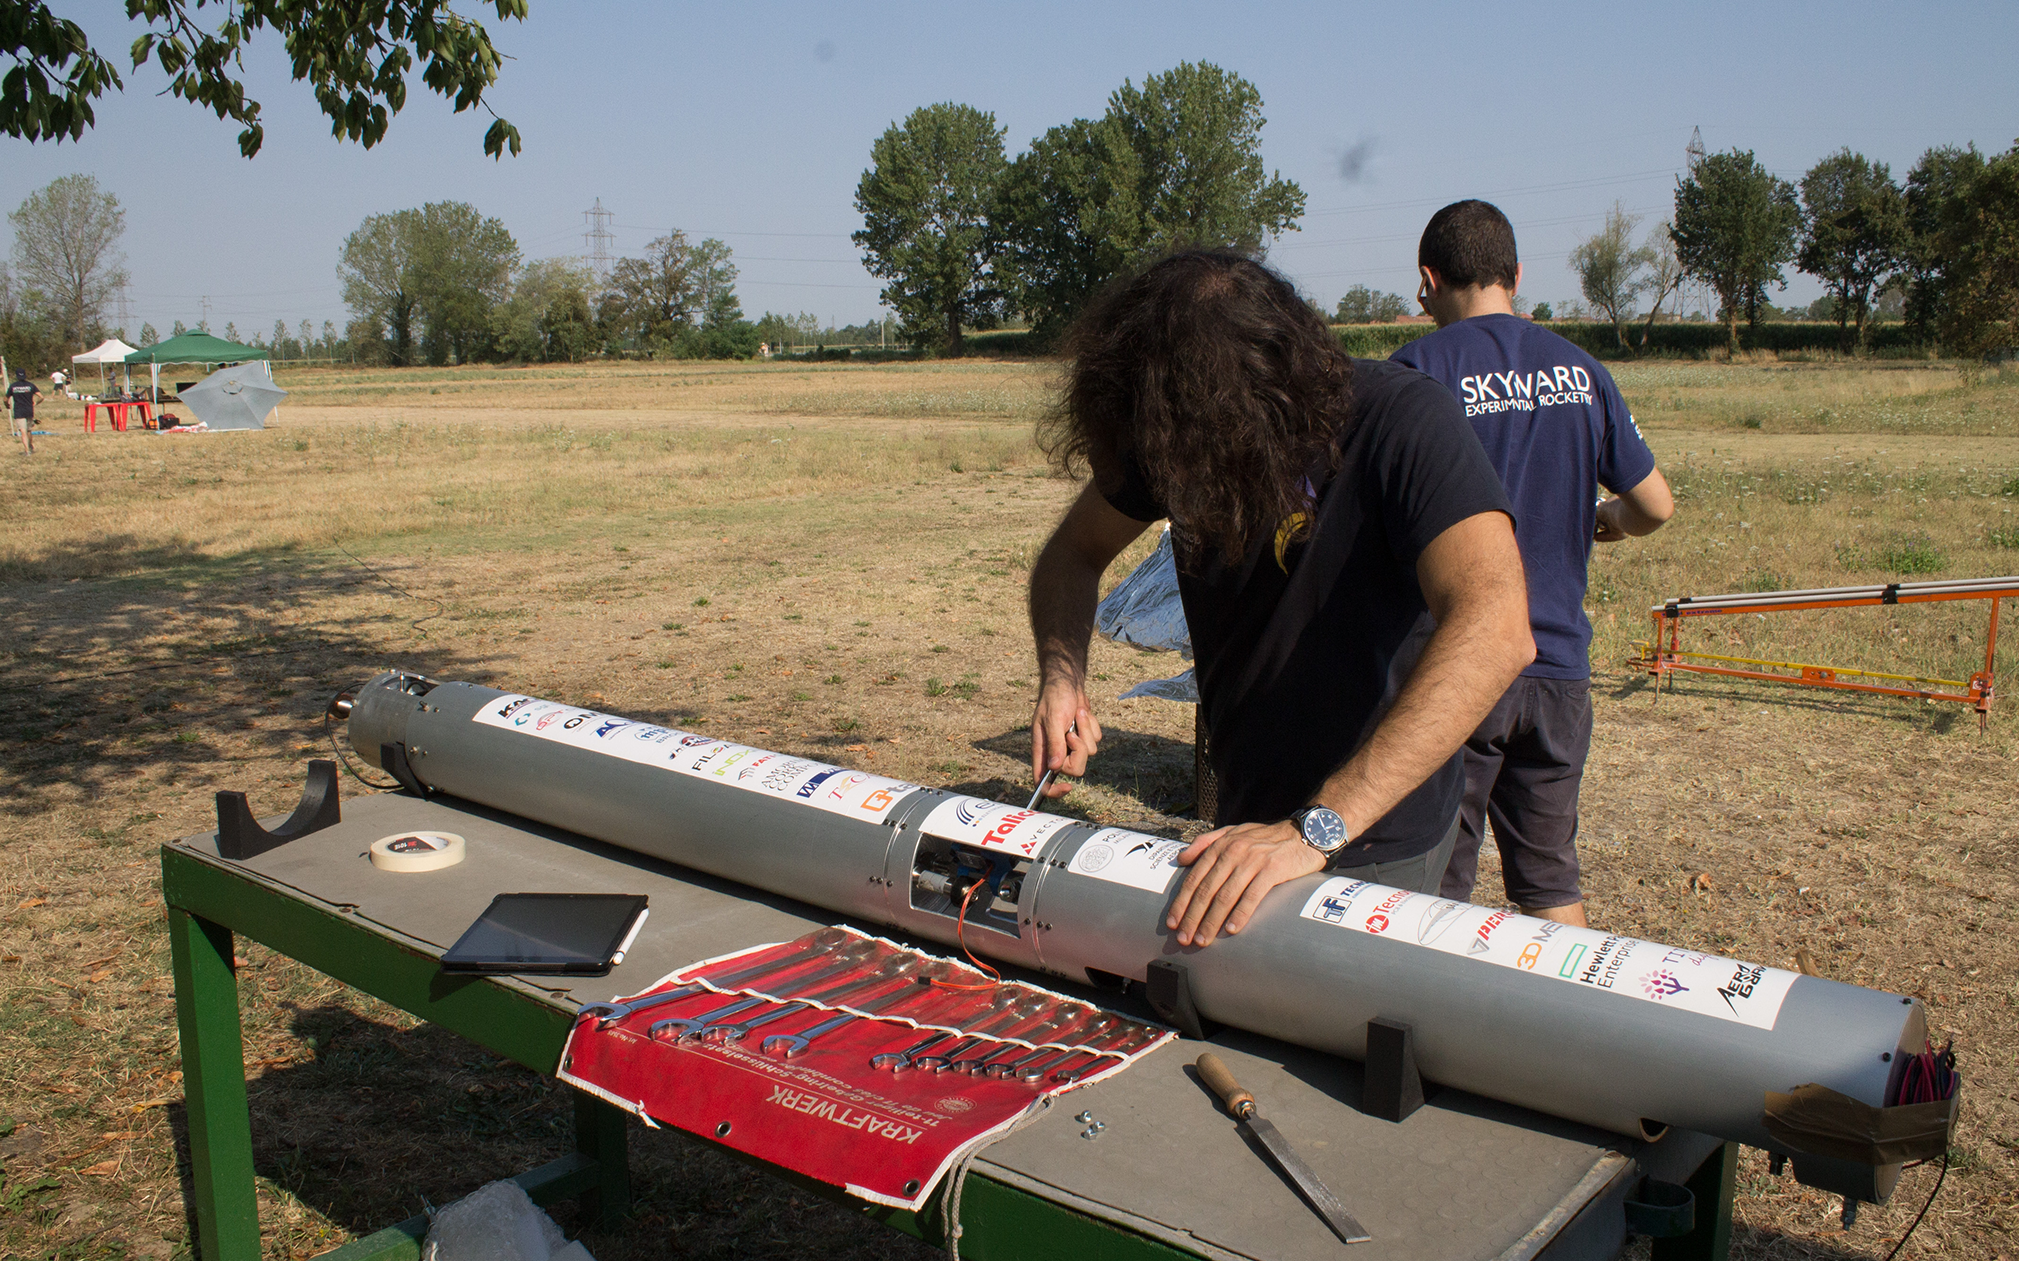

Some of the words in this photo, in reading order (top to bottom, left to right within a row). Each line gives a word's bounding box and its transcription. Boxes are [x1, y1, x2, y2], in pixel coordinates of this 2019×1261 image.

[1580, 937, 1615, 984] Hewlett
[1597, 939, 1641, 989] Enterprise
[765, 1084, 923, 1145] KRAFTWERK
